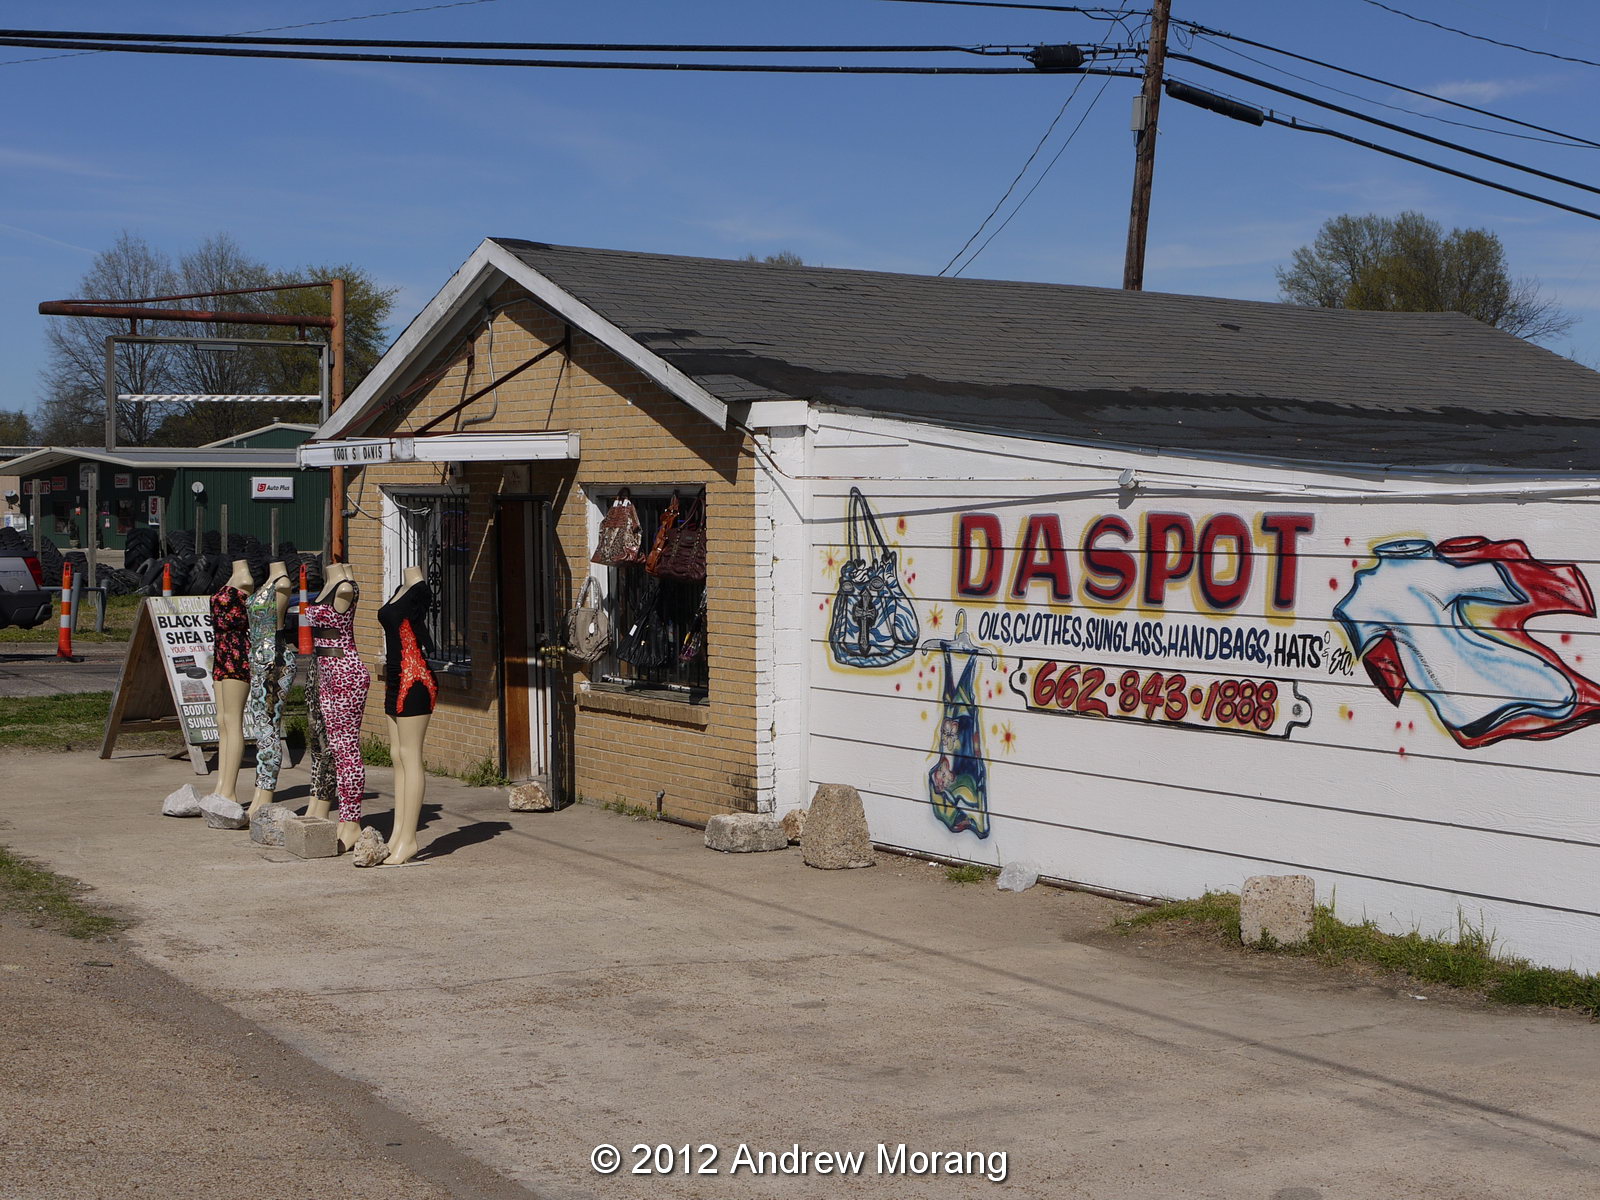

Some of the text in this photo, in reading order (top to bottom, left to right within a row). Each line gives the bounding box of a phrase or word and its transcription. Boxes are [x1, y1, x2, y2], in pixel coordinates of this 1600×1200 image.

[351, 447, 357, 460] S
[363, 445, 383, 459] DAVIS
[139, 476, 155, 491] TIRES
[157, 614, 203, 629] BLACK
[166, 631, 203, 645] SHEA
[170, 646, 187, 654] YOUR
[189, 645, 205, 653] SKIN
[182, 705, 205, 716] BODY
